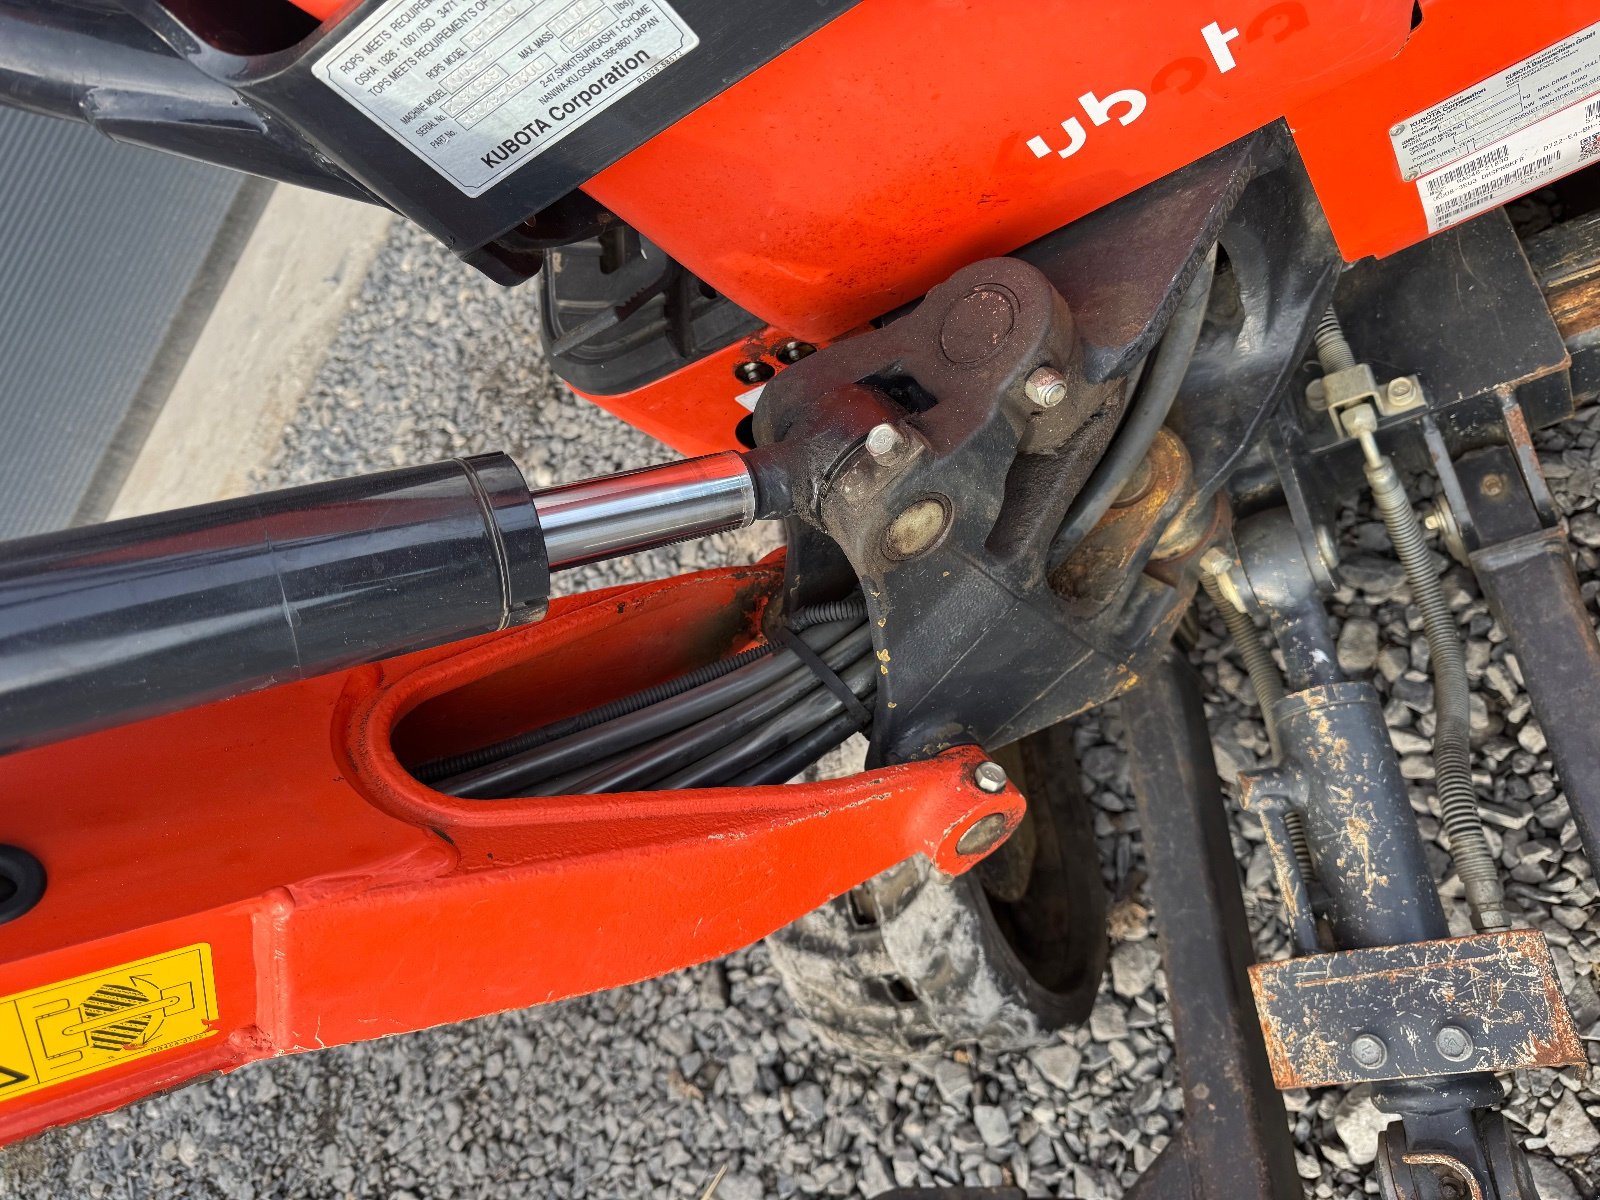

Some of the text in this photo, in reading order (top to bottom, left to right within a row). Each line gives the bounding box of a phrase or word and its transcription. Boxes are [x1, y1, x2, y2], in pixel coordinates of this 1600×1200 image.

[615, 4, 652, 33] 1-CHOME
[339, 53, 365, 75] ROPS
[362, 30, 392, 56] MEETS
[354, 66, 379, 86] OSHA
[378, 51, 398, 68] 1926
[400, 18, 436, 49] 1001/ISO
[368, 77, 392, 98] TOPS
[391, 56, 418, 81] MEETS
[413, 8, 478, 61] REQUIREMENTS
[533, 31, 555, 49] MASS
[425, 63, 446, 80] ROPS
[443, 47, 468, 66] MODEL
[400, 102, 427, 125] MACHINE
[425, 88, 448, 107] MODEL
[481, 49, 651, 169] KUBOTA Corporation
[1409, 110, 1441, 128] KUBOTA
[415, 118, 438, 138] SERIAL
[429, 133, 446, 149] PART
